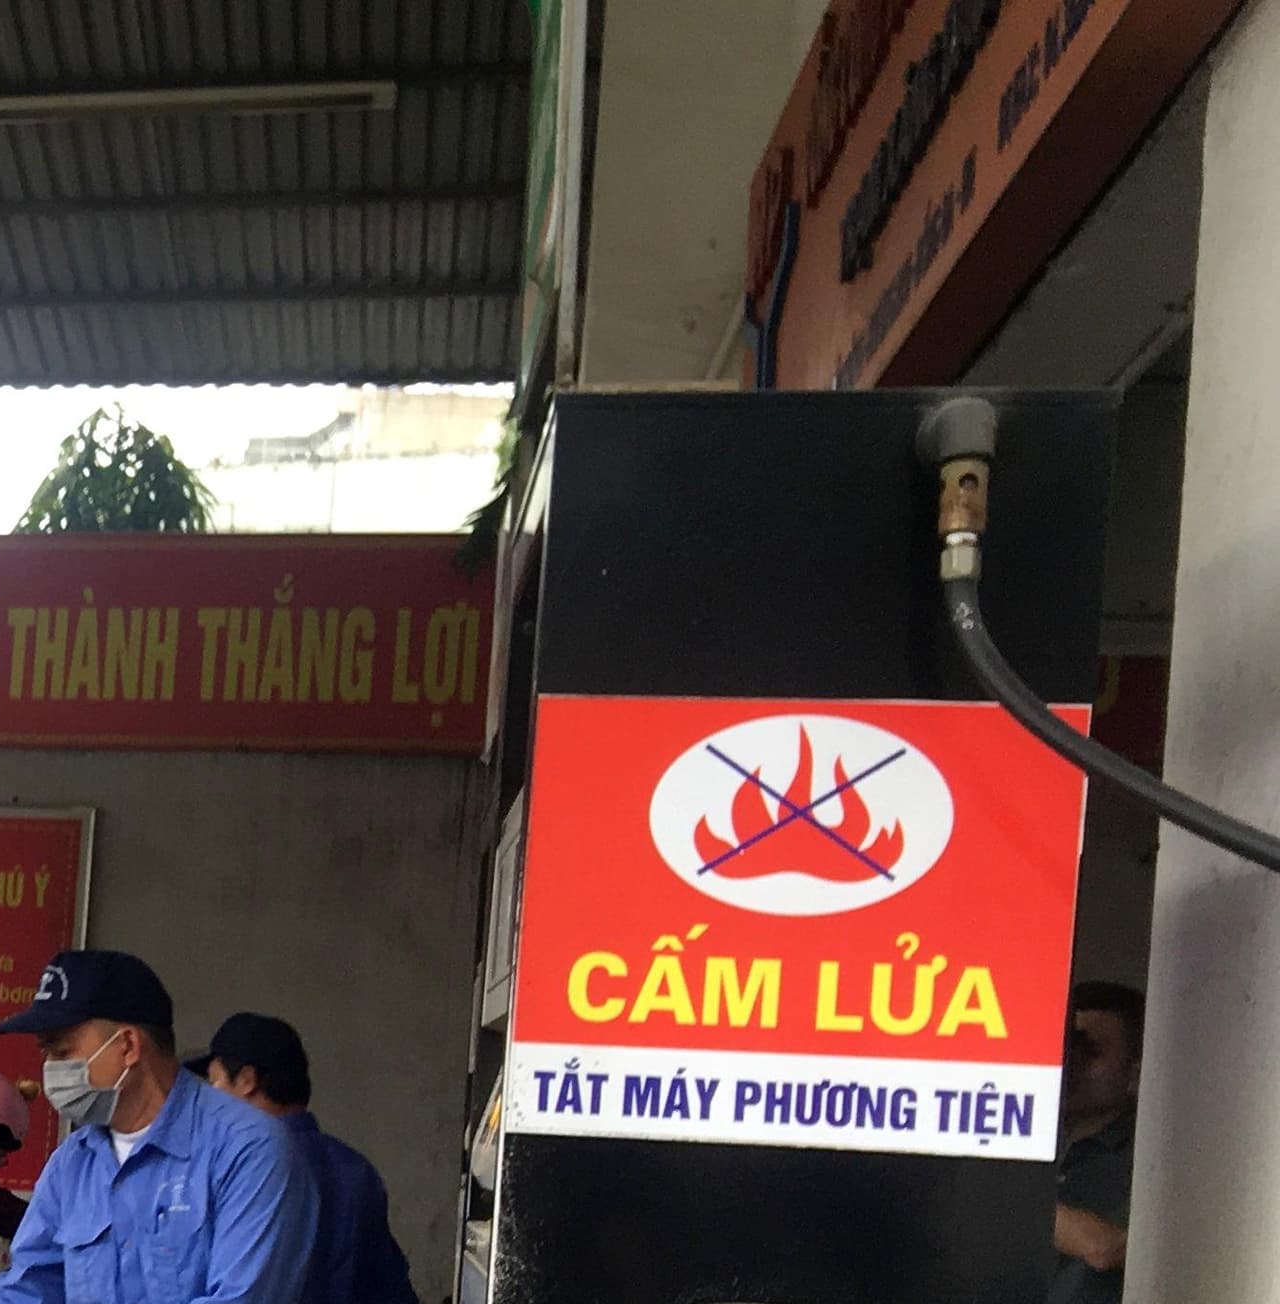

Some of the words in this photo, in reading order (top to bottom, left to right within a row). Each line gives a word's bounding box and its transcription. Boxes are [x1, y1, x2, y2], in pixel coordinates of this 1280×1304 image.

[8, 585, 179, 700] THÀNH
[198, 573, 375, 703] THẮNG
[392, 602, 480, 727] LỢI
[35, 865, 51, 907] Ý
[567, 924, 782, 1029] CẤM
[815, 932, 1008, 1039] LỬA
[534, 1057, 608, 1114] TẮT
[623, 1067, 720, 1121] MÁY
[734, 1078, 918, 1132] PHƯƠNG
[935, 1082, 1035, 1145] TIỆN
